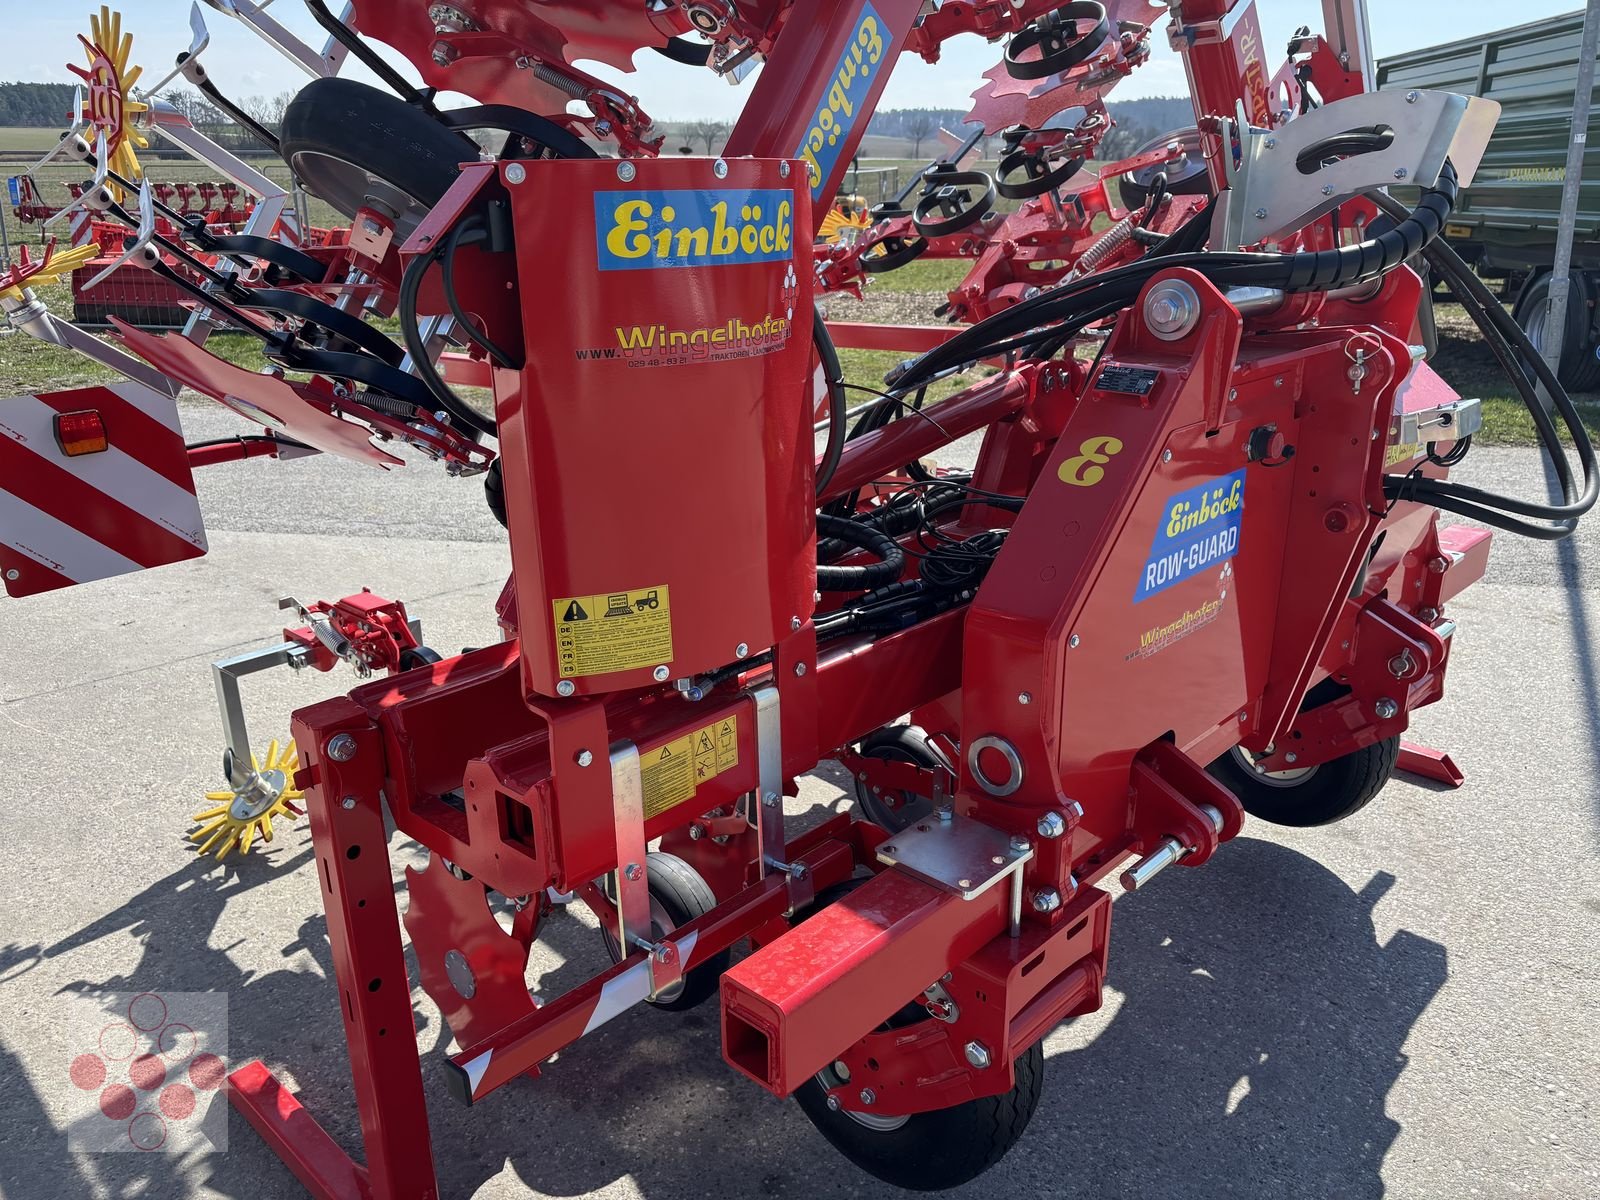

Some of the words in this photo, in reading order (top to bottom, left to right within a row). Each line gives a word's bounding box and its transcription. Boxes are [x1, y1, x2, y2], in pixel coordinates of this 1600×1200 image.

[798, 15, 884, 189] Einböck
[606, 199, 791, 259] Einböck
[628, 360, 645, 368] 029
[710, 349, 750, 361] TRAKTOREN
[1058, 436, 1124, 487] E
[1166, 479, 1241, 538] Einböck
[1145, 525, 1238, 592] ROW-GUARD
